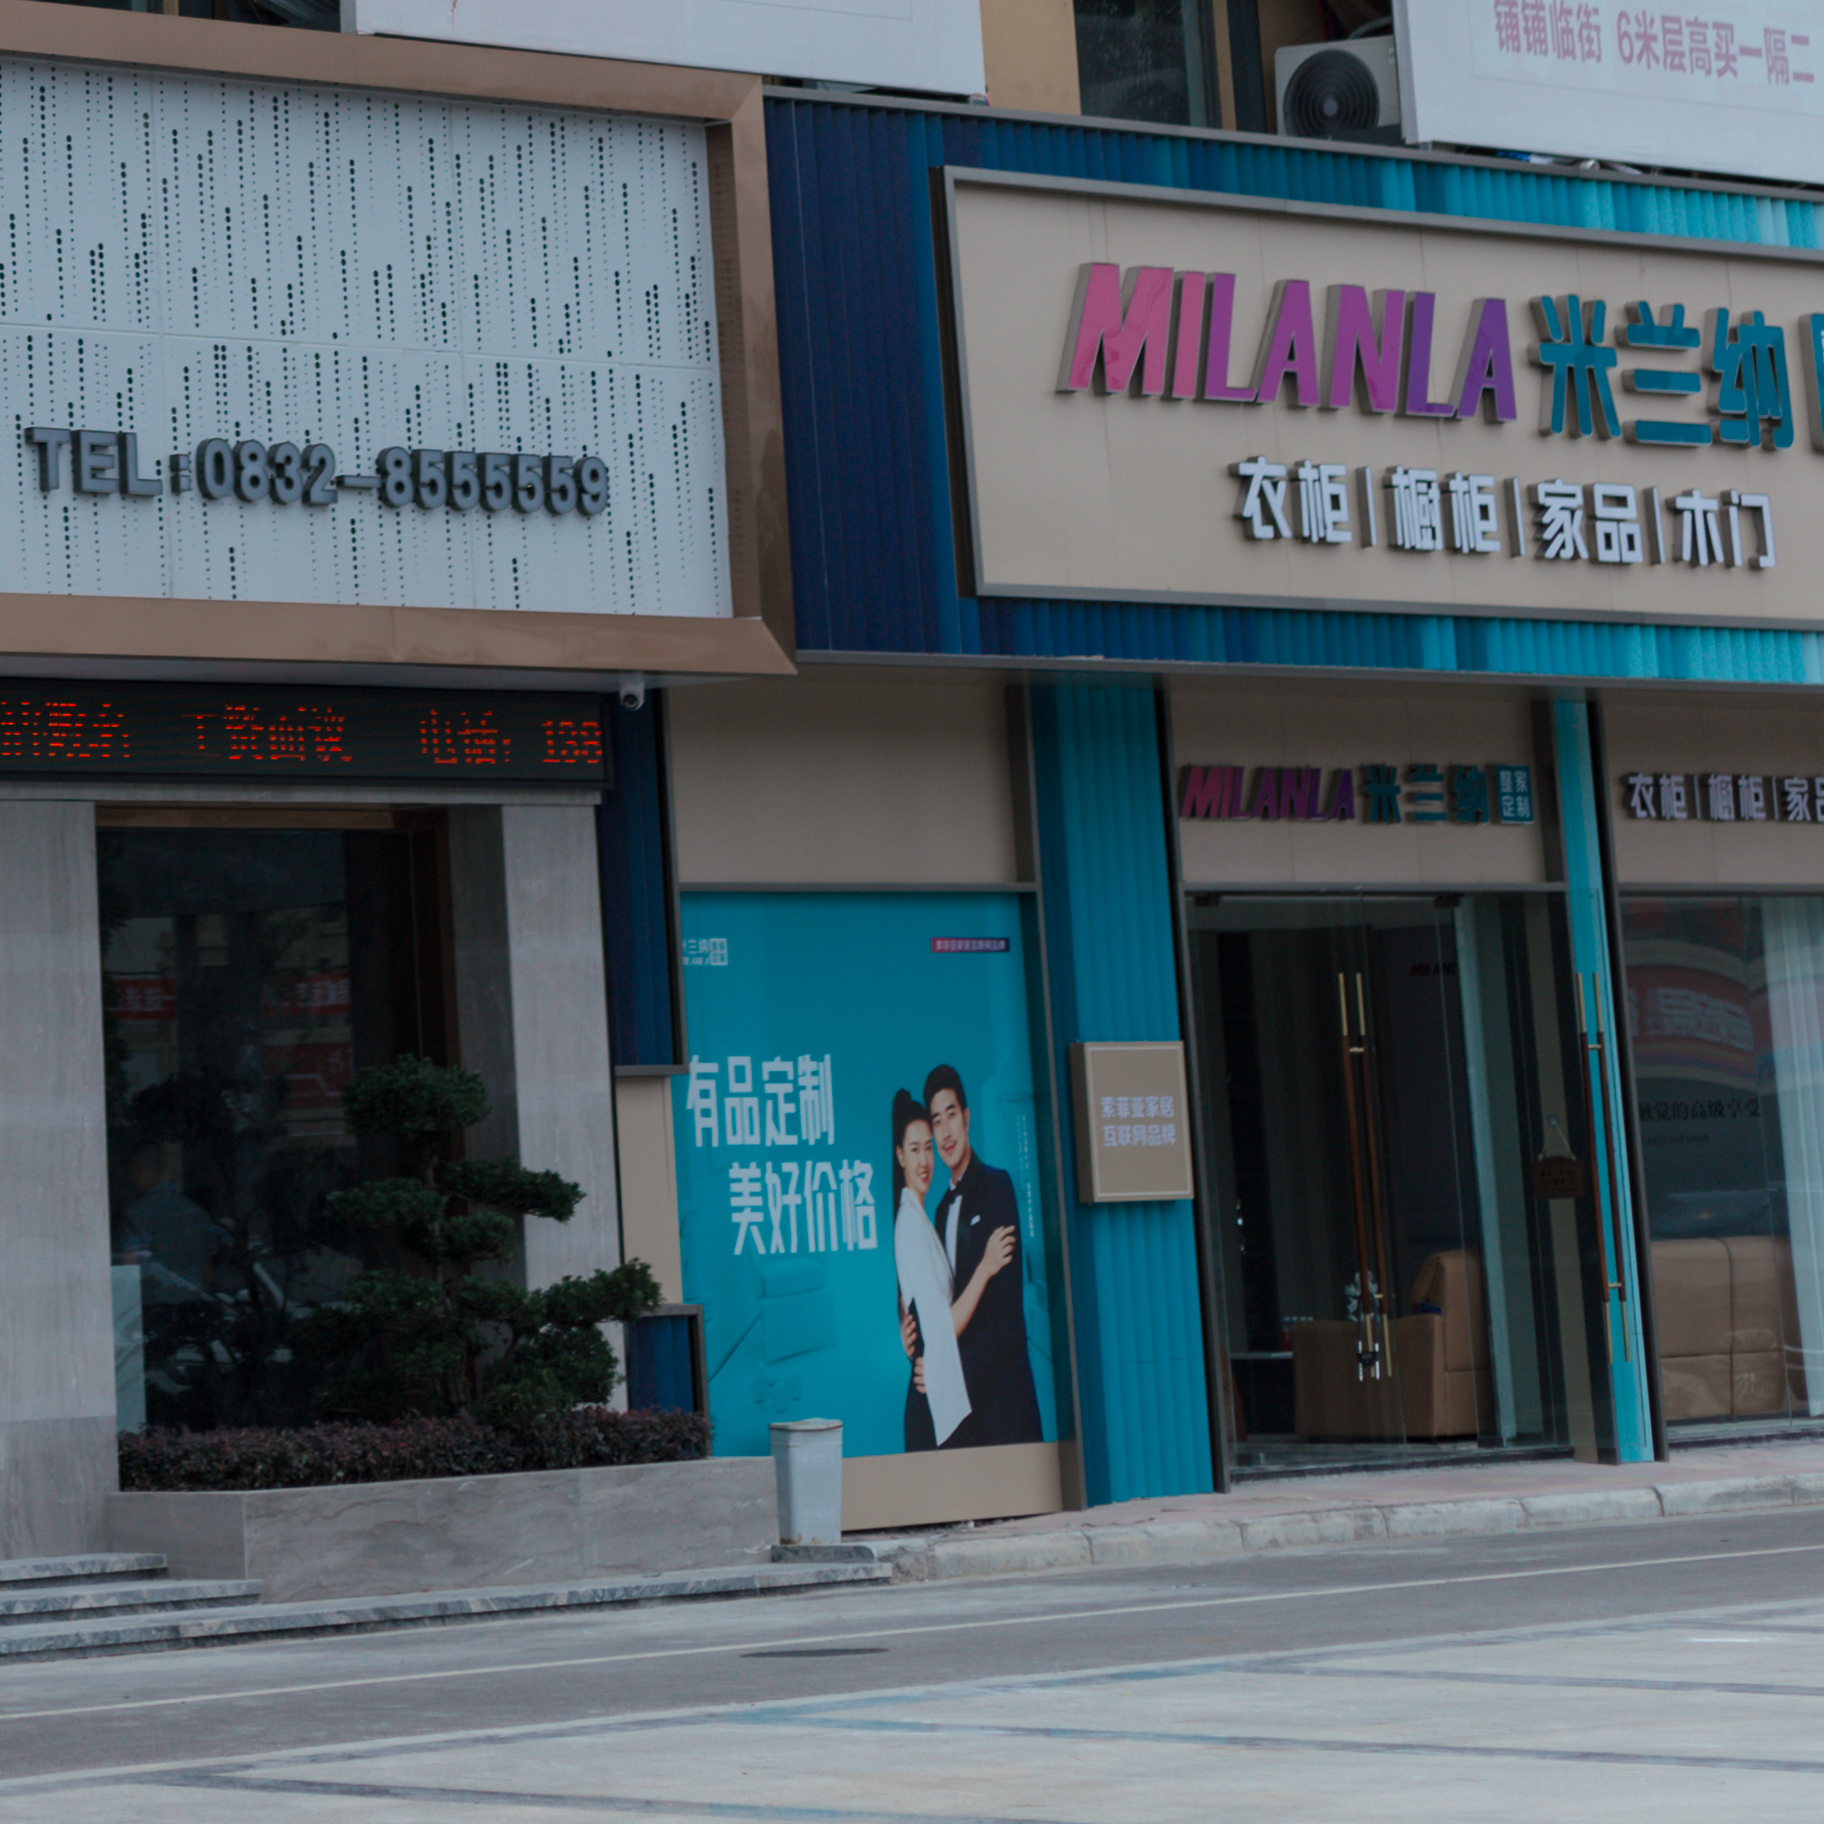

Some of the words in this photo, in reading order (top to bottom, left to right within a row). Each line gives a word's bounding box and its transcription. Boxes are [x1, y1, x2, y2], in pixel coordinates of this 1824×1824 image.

[1617, 9, 1816, 86] 6米层高买一隔二
[1056, 261, 1518, 423] MILANLA
[1529, 292, 1795, 450] 米兰纳
[1180, 765, 1356, 822] MILANLA
[1360, 763, 1490, 825] 米兰纳
[686, 1054, 835, 1147] 有品定制
[1103, 1124, 1176, 1147] 互联网品牌
[728, 1159, 878, 1256] 美好价格
